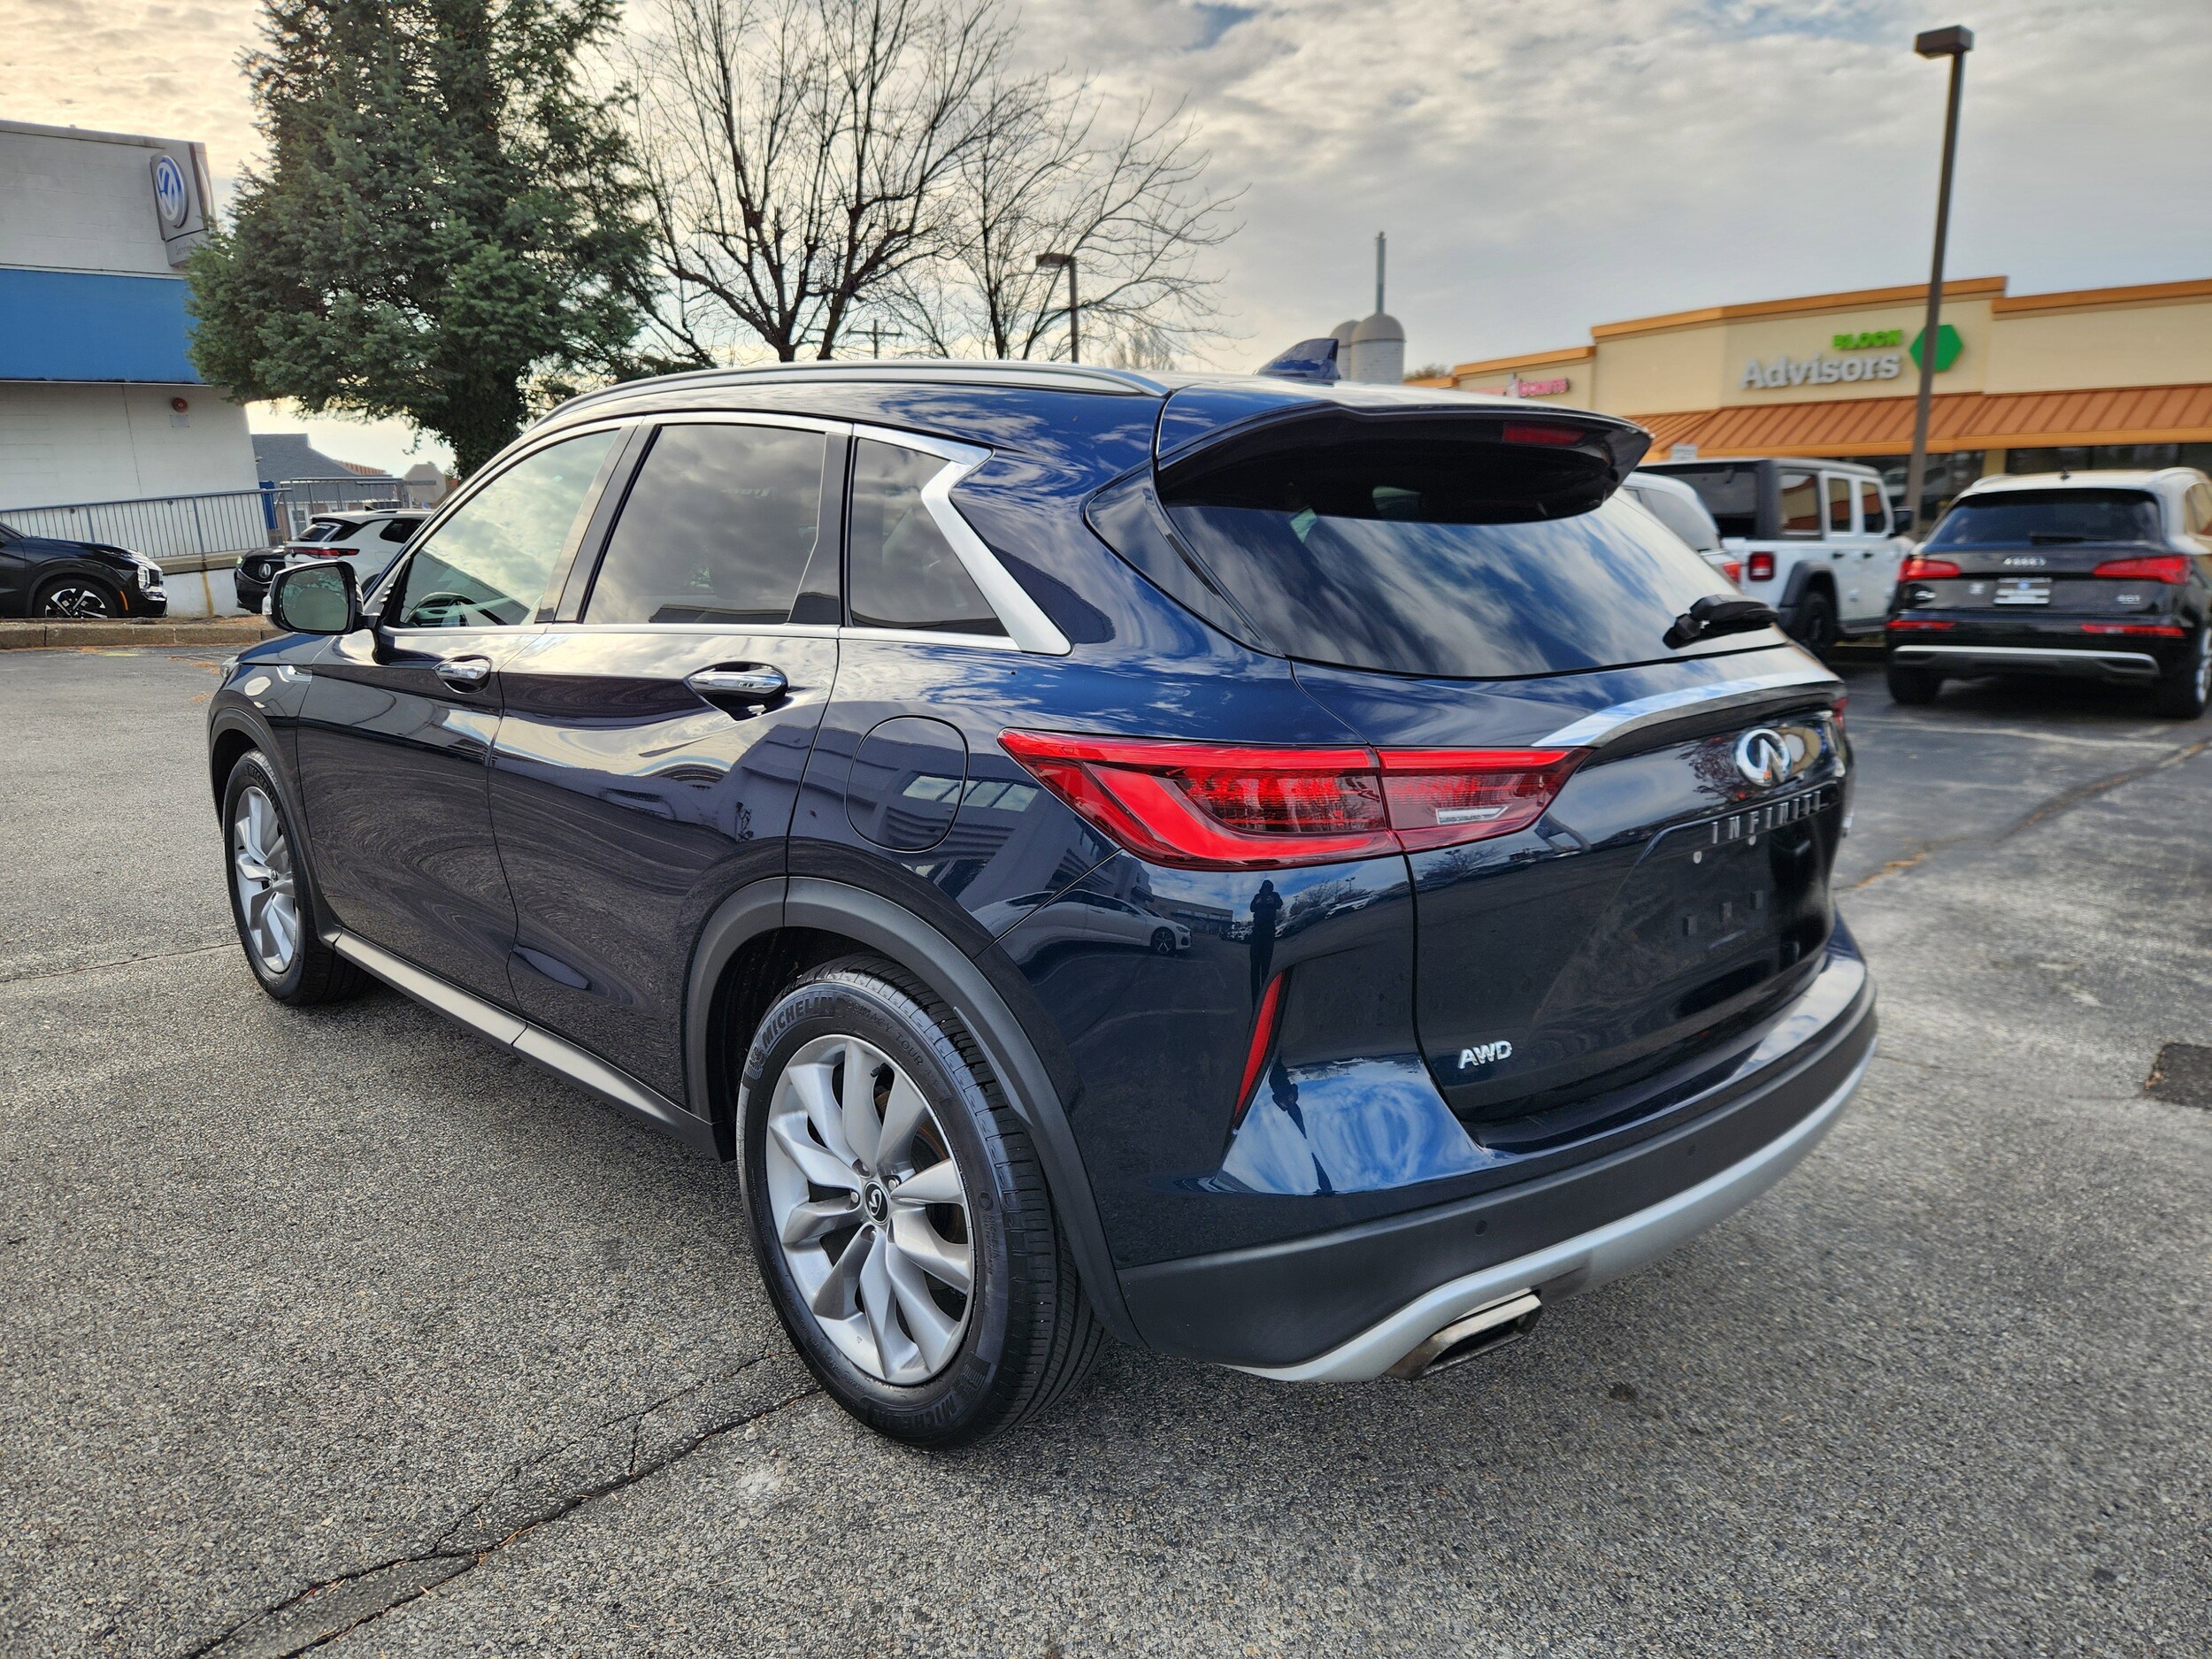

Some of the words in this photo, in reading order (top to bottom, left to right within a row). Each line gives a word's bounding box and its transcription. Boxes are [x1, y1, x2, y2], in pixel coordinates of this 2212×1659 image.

[1832, 329, 1901, 349] BLOCK
[1740, 352, 1901, 389] Advisors
[761, 995, 837, 1049] MICHELIN
[895, 1032, 925, 1066] TOUR
[1457, 1041, 1513, 1070] AWD
[988, 1214, 1001, 1261] MICHELIN
